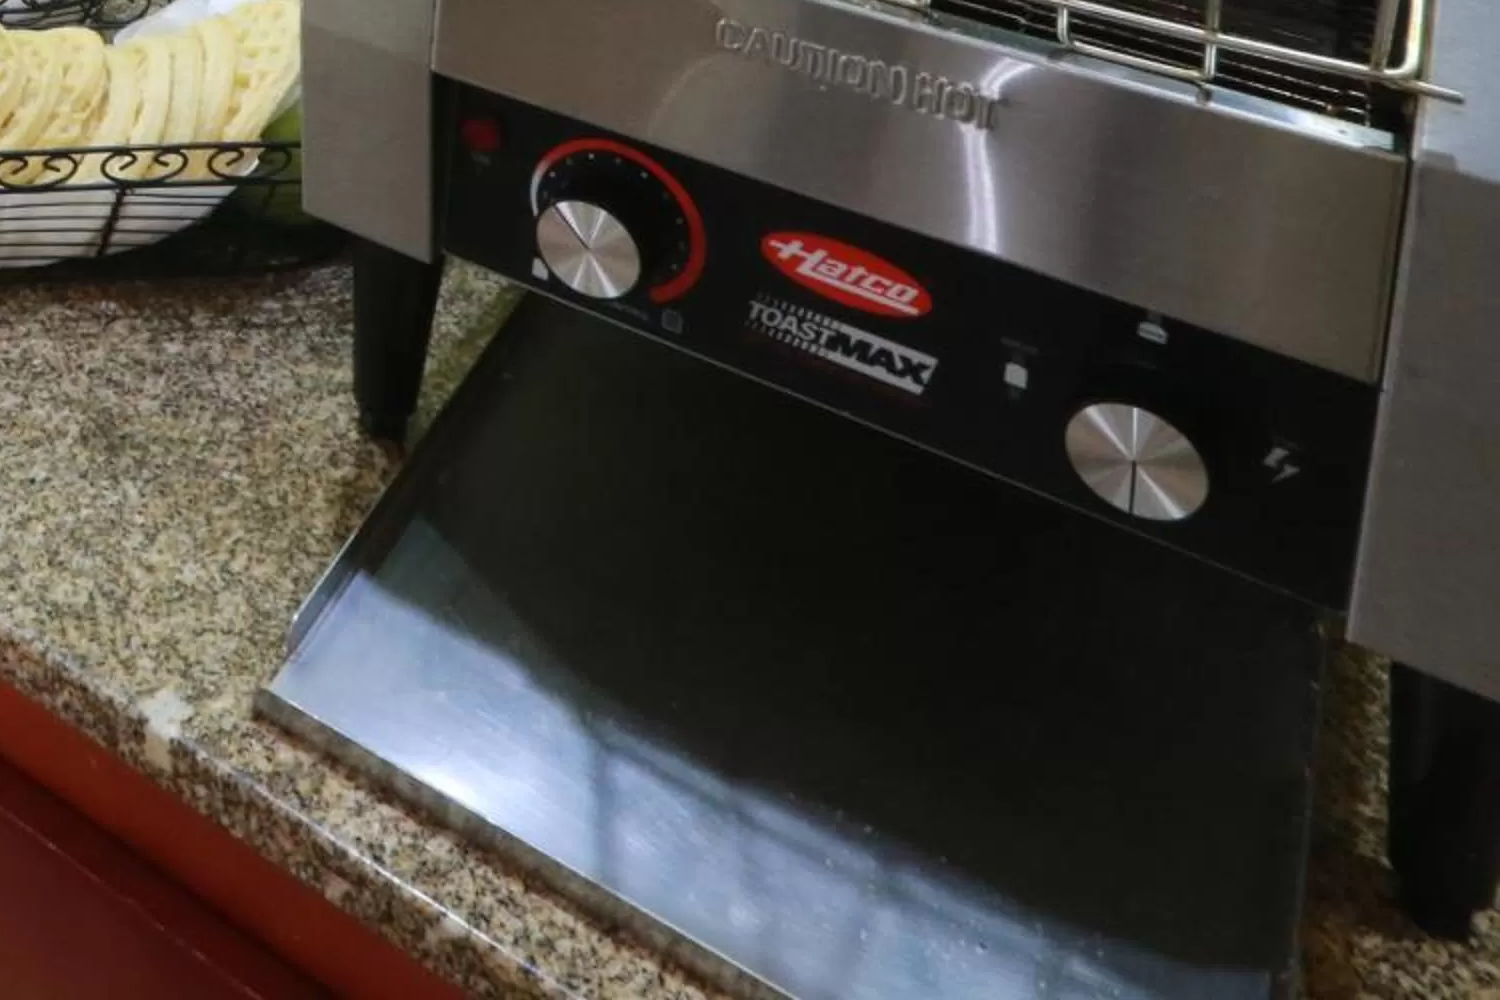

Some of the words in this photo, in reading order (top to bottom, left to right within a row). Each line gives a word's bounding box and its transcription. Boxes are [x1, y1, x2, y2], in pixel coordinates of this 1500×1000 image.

[714, 17, 908, 105] CAUTION
[911, 70, 1009, 131] HOT
[768, 239, 921, 316] Hatco
